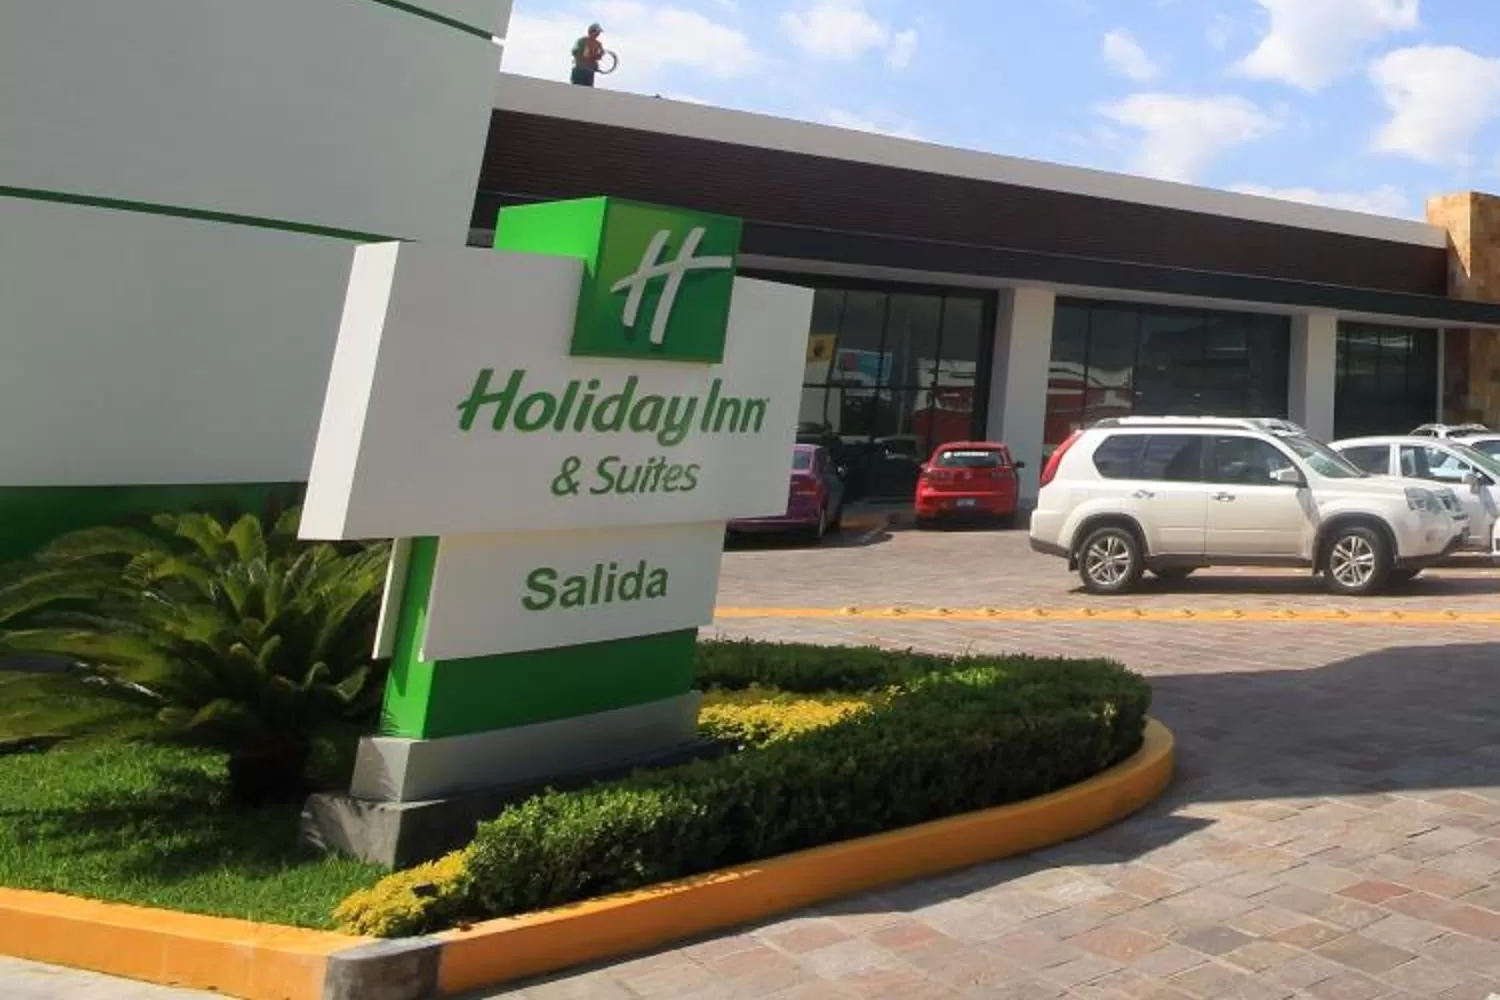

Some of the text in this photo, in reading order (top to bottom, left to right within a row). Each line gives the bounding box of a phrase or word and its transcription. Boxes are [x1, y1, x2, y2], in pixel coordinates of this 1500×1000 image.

[457, 368, 766, 447] Holiday Inn
[551, 456, 700, 496] & Suites
[521, 560, 669, 611] Salida
